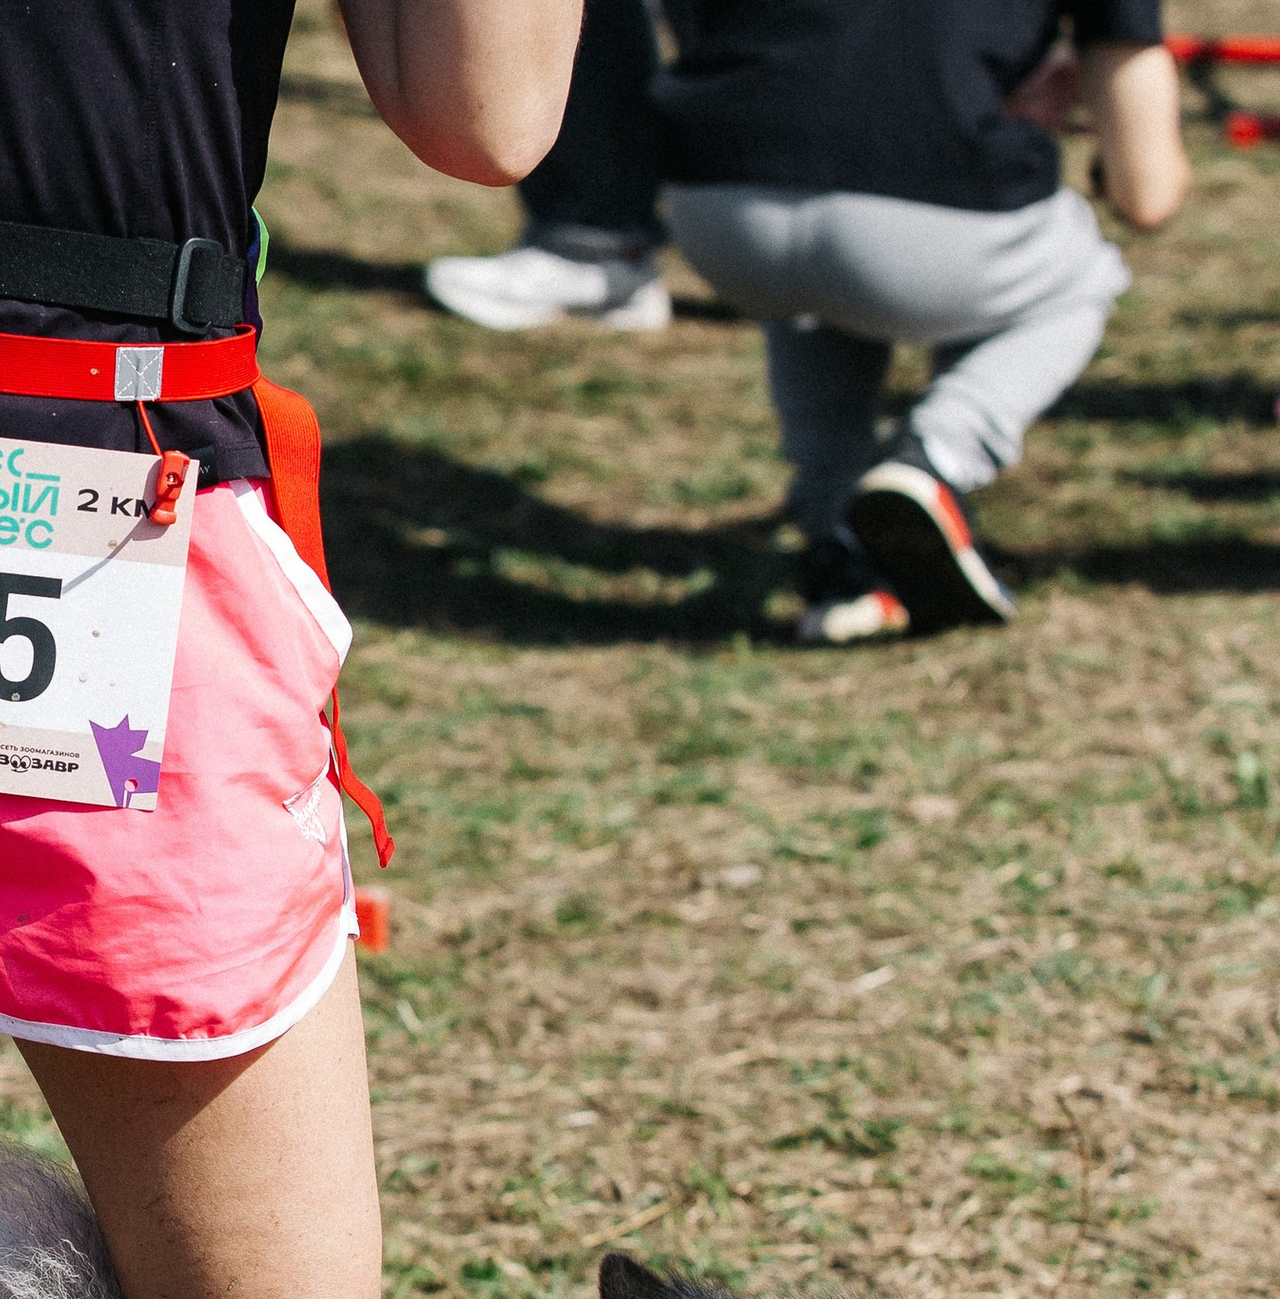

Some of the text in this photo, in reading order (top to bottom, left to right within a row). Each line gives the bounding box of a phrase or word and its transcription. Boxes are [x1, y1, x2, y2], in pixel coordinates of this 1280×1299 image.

[76, 488, 100, 513] 2
[0, 744, 80, 759] СЕТЬ ЗООМАГАЗИНОВ
